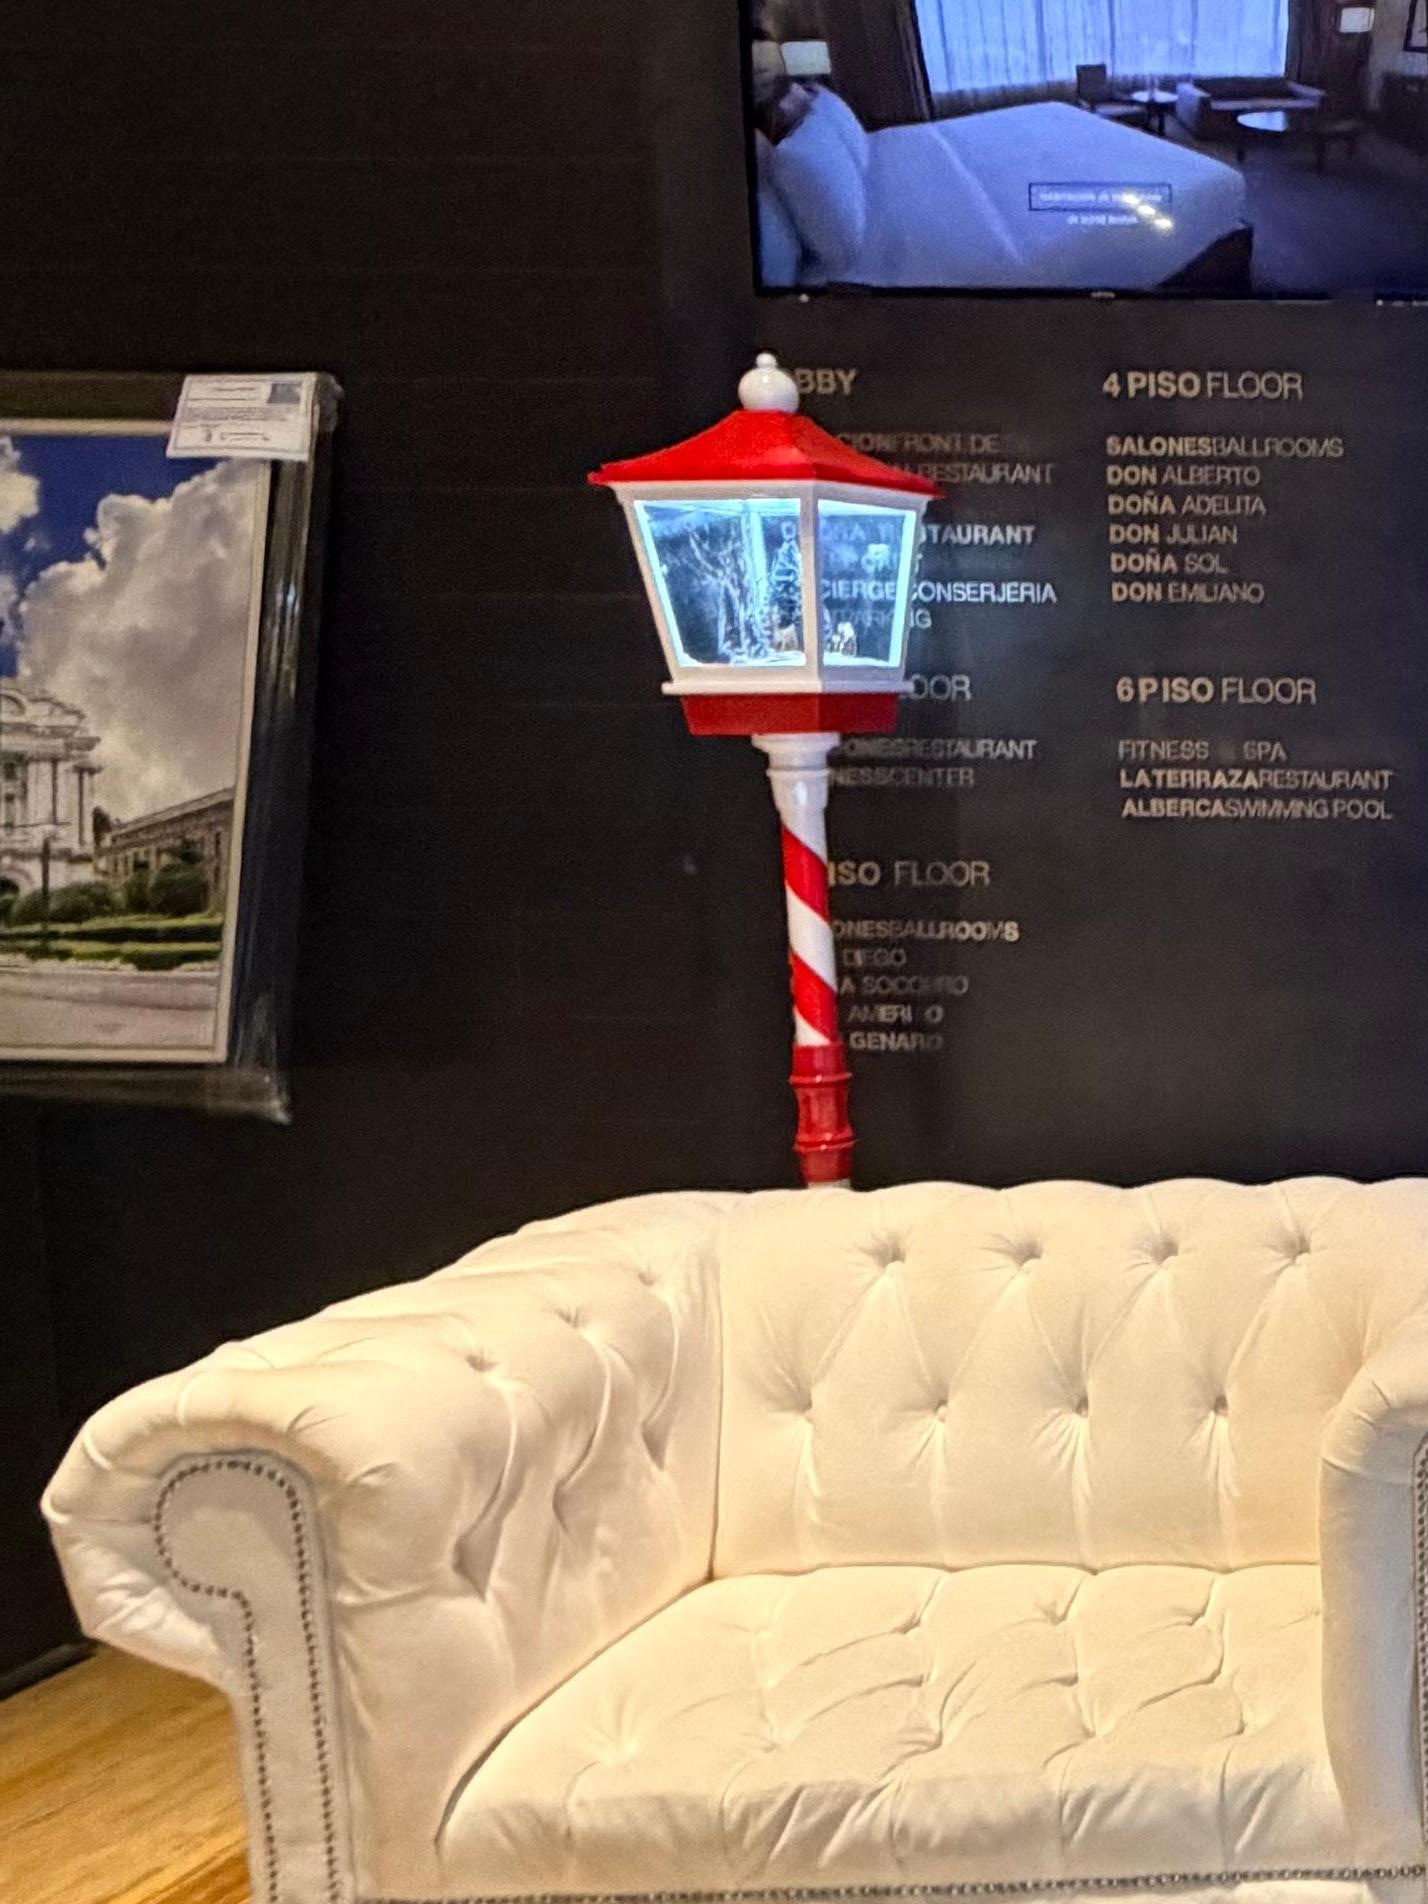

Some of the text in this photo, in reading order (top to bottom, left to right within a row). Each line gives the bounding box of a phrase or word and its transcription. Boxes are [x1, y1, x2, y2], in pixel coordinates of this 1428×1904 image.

[797, 369, 857, 394] BBY
[1103, 371, 1303, 400] 4 PISO FLOOR
[1107, 465, 1260, 486] DON ALBERTO
[1108, 490, 1266, 516] DOÑA ADELITA
[1110, 524, 1238, 544] DON JULIAN
[1110, 547, 1229, 574] DOÑA SOL
[1112, 582, 1162, 603] DON
[909, 674, 971, 701] OOR
[1116, 677, 1317, 704] 6 PISO FLOOR
[1118, 740, 1209, 760] FITNESS
[1244, 741, 1287, 761] SPA
[1333, 800, 1393, 820] POOL
[828, 860, 991, 887] ISO FLOOR
[848, 1004, 944, 1024] AMERIO
